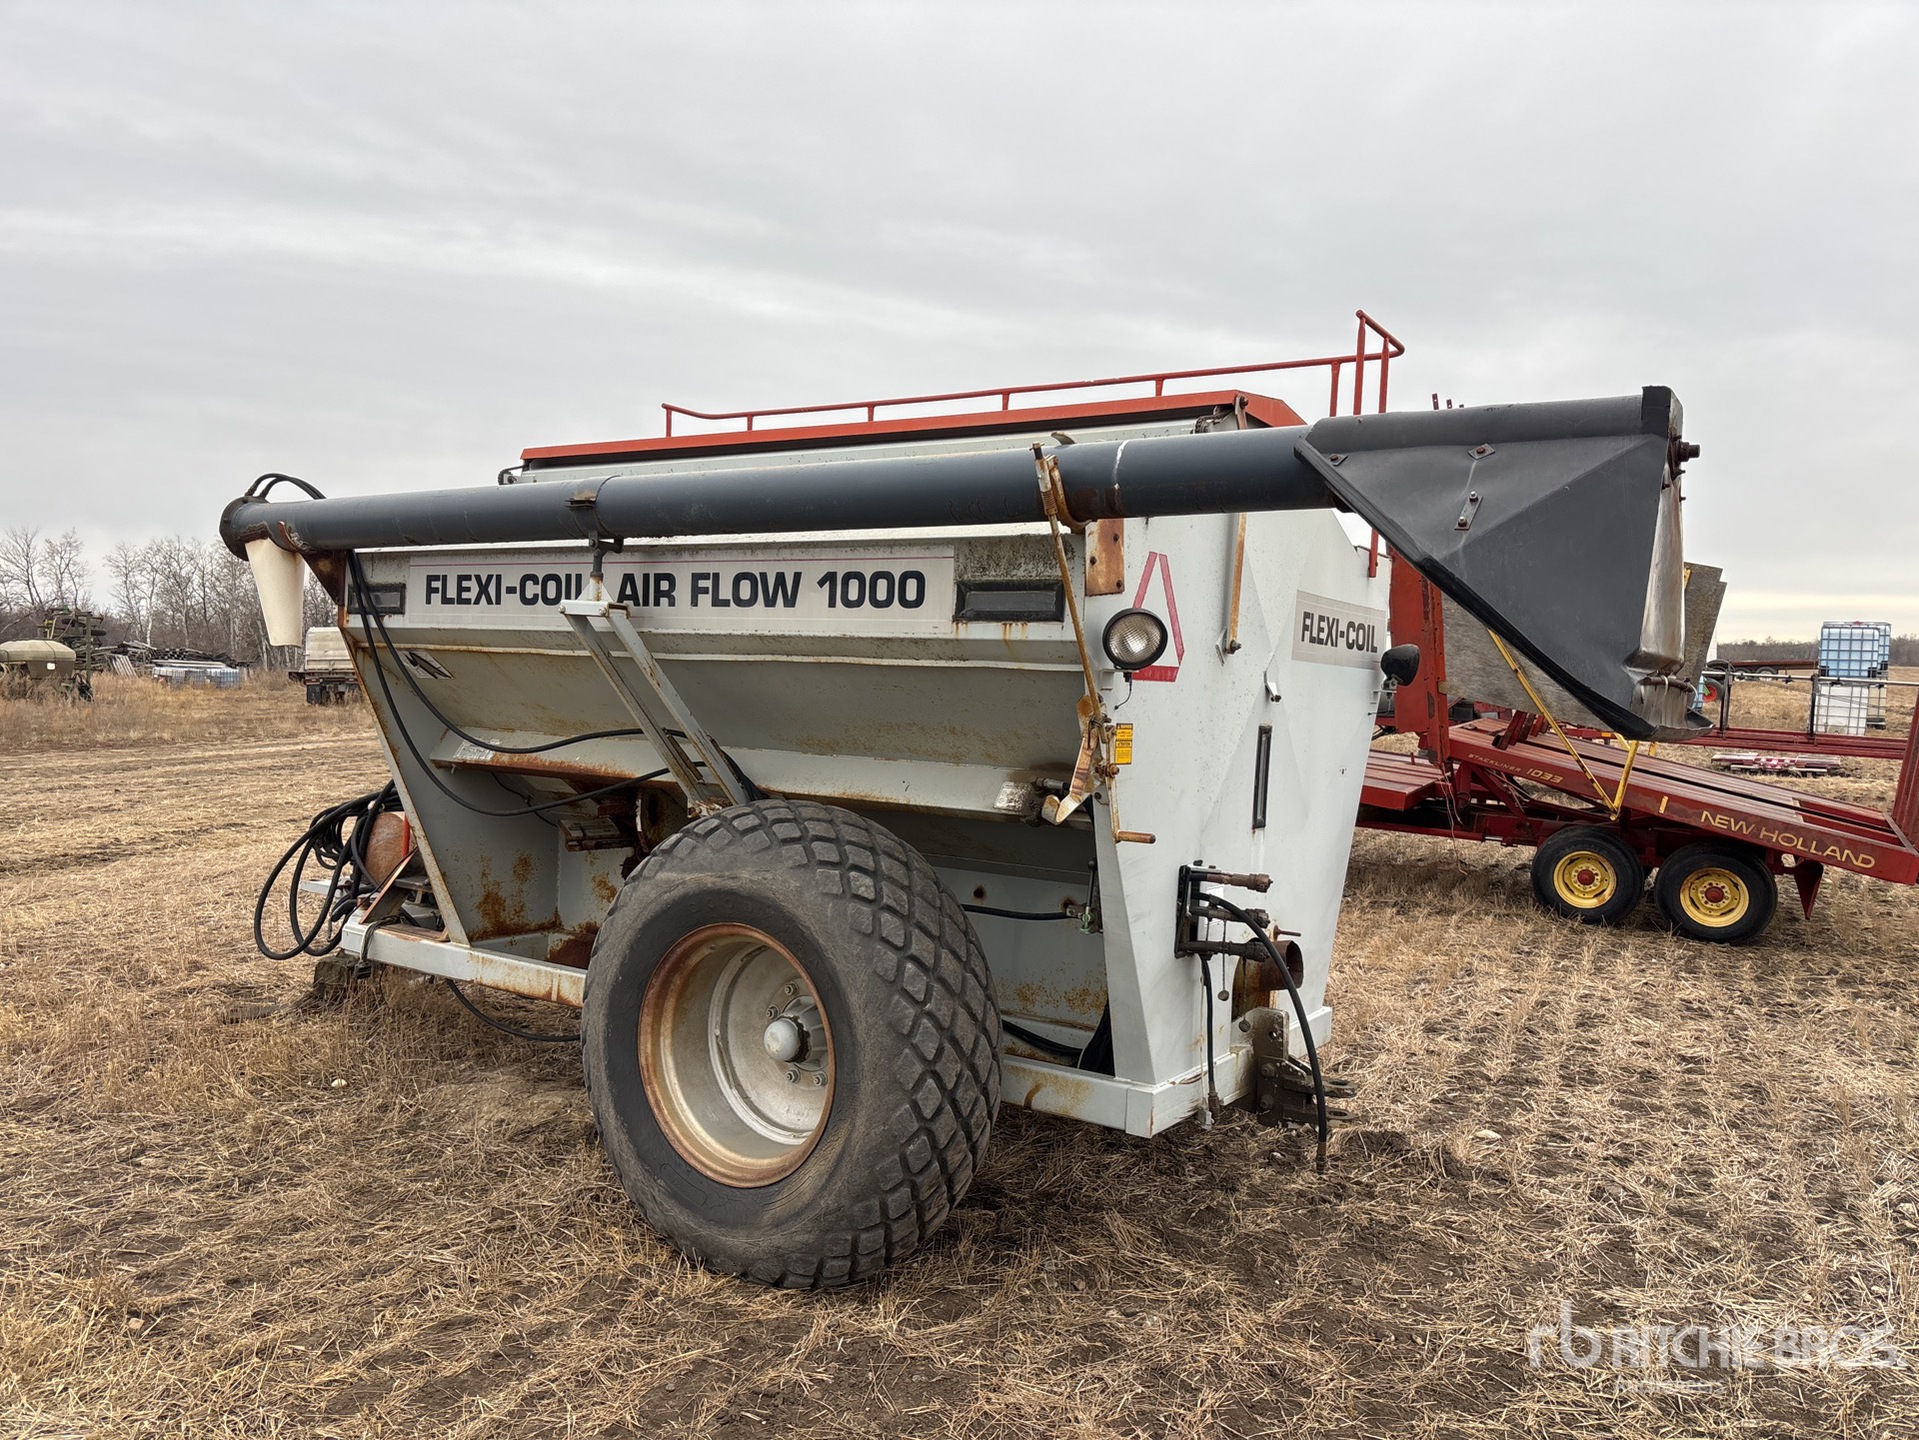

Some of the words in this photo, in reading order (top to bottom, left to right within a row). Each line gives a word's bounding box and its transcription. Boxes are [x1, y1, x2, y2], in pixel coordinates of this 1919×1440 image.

[616, 572, 676, 607] AIR
[690, 571, 802, 608] FLOW
[816, 570, 926, 609] 1000
[1301, 611, 1378, 654] FLEXI-COIL
[1467, 753, 1521, 772] STACKLINER
[1526, 768, 1563, 784] 1033
[1701, 810, 1755, 835] NEW
[1759, 826, 1876, 869] HOLLAND
